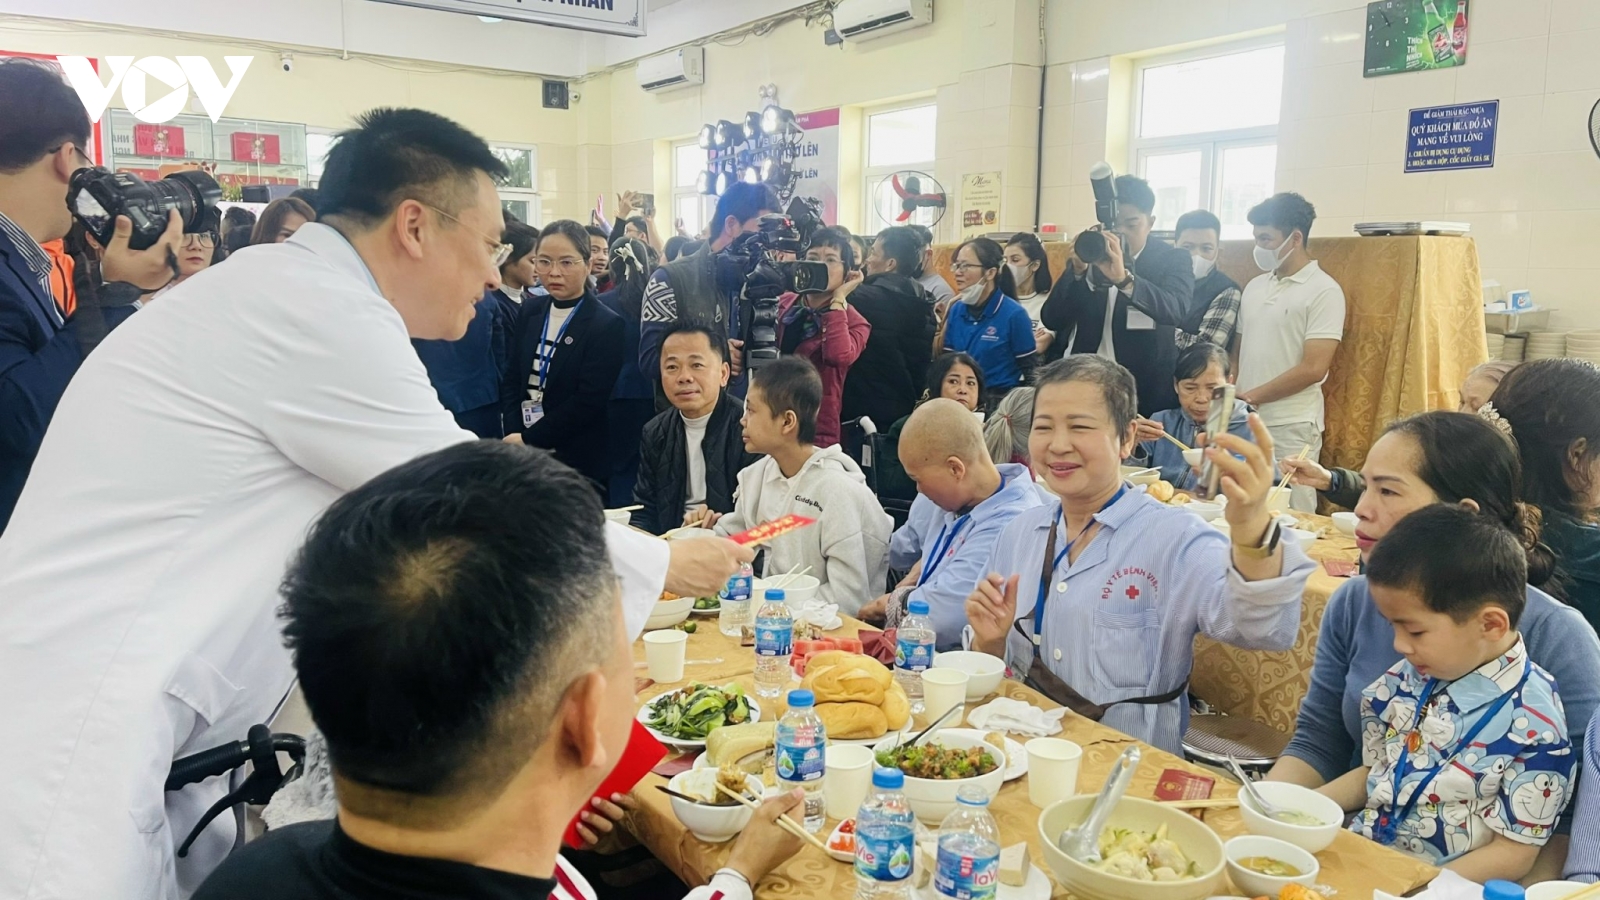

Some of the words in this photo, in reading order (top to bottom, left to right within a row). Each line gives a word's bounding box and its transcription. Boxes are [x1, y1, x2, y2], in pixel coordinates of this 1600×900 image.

[1427, 121, 1451, 133] KHÁCH
[1452, 121, 1468, 131] MUA
[1481, 117, 1493, 128] ĂN
[1417, 136, 1437, 146] MANG
[1450, 134, 1462, 143] VUI
[1463, 131, 1483, 142] LÒNG
[802, 142, 819, 157] LÊN
[804, 169, 818, 179] LÊN
[855, 845, 875, 864] Vie
[973, 868, 1000, 885] laV
